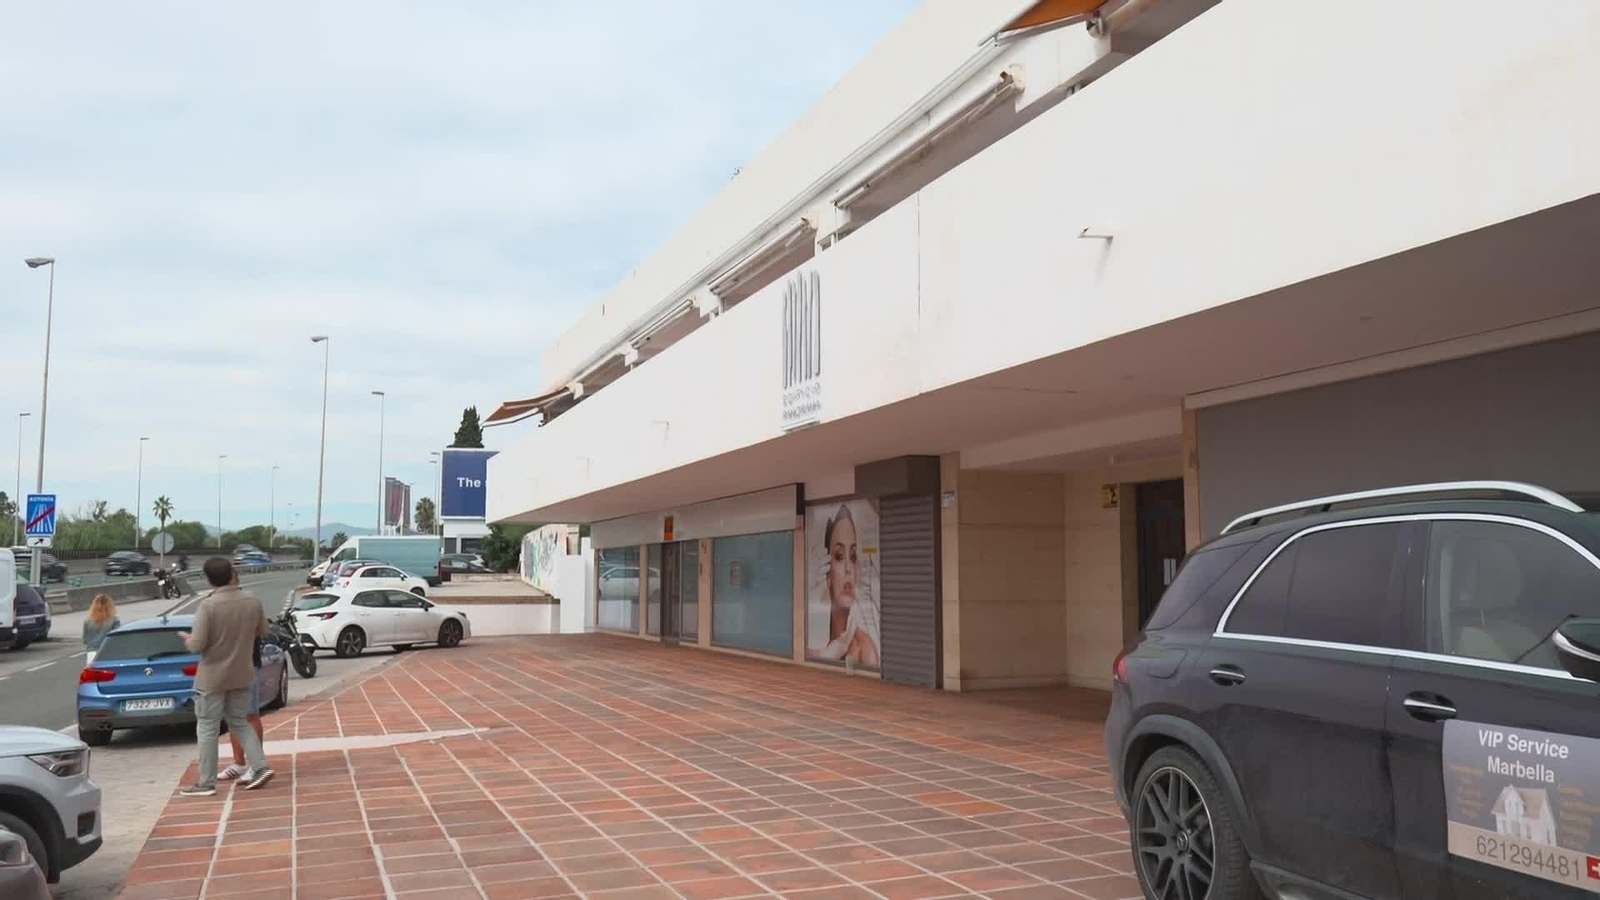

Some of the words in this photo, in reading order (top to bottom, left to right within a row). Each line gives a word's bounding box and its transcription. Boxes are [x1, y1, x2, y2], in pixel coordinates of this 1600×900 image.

[457, 477, 481, 488] The
[153, 699, 170, 708] JVX
[1478, 729, 1504, 748] VIP
[1507, 733, 1569, 759] Service
[1487, 755, 1555, 783] Marbella
[1476, 835, 1580, 880] 621294481
